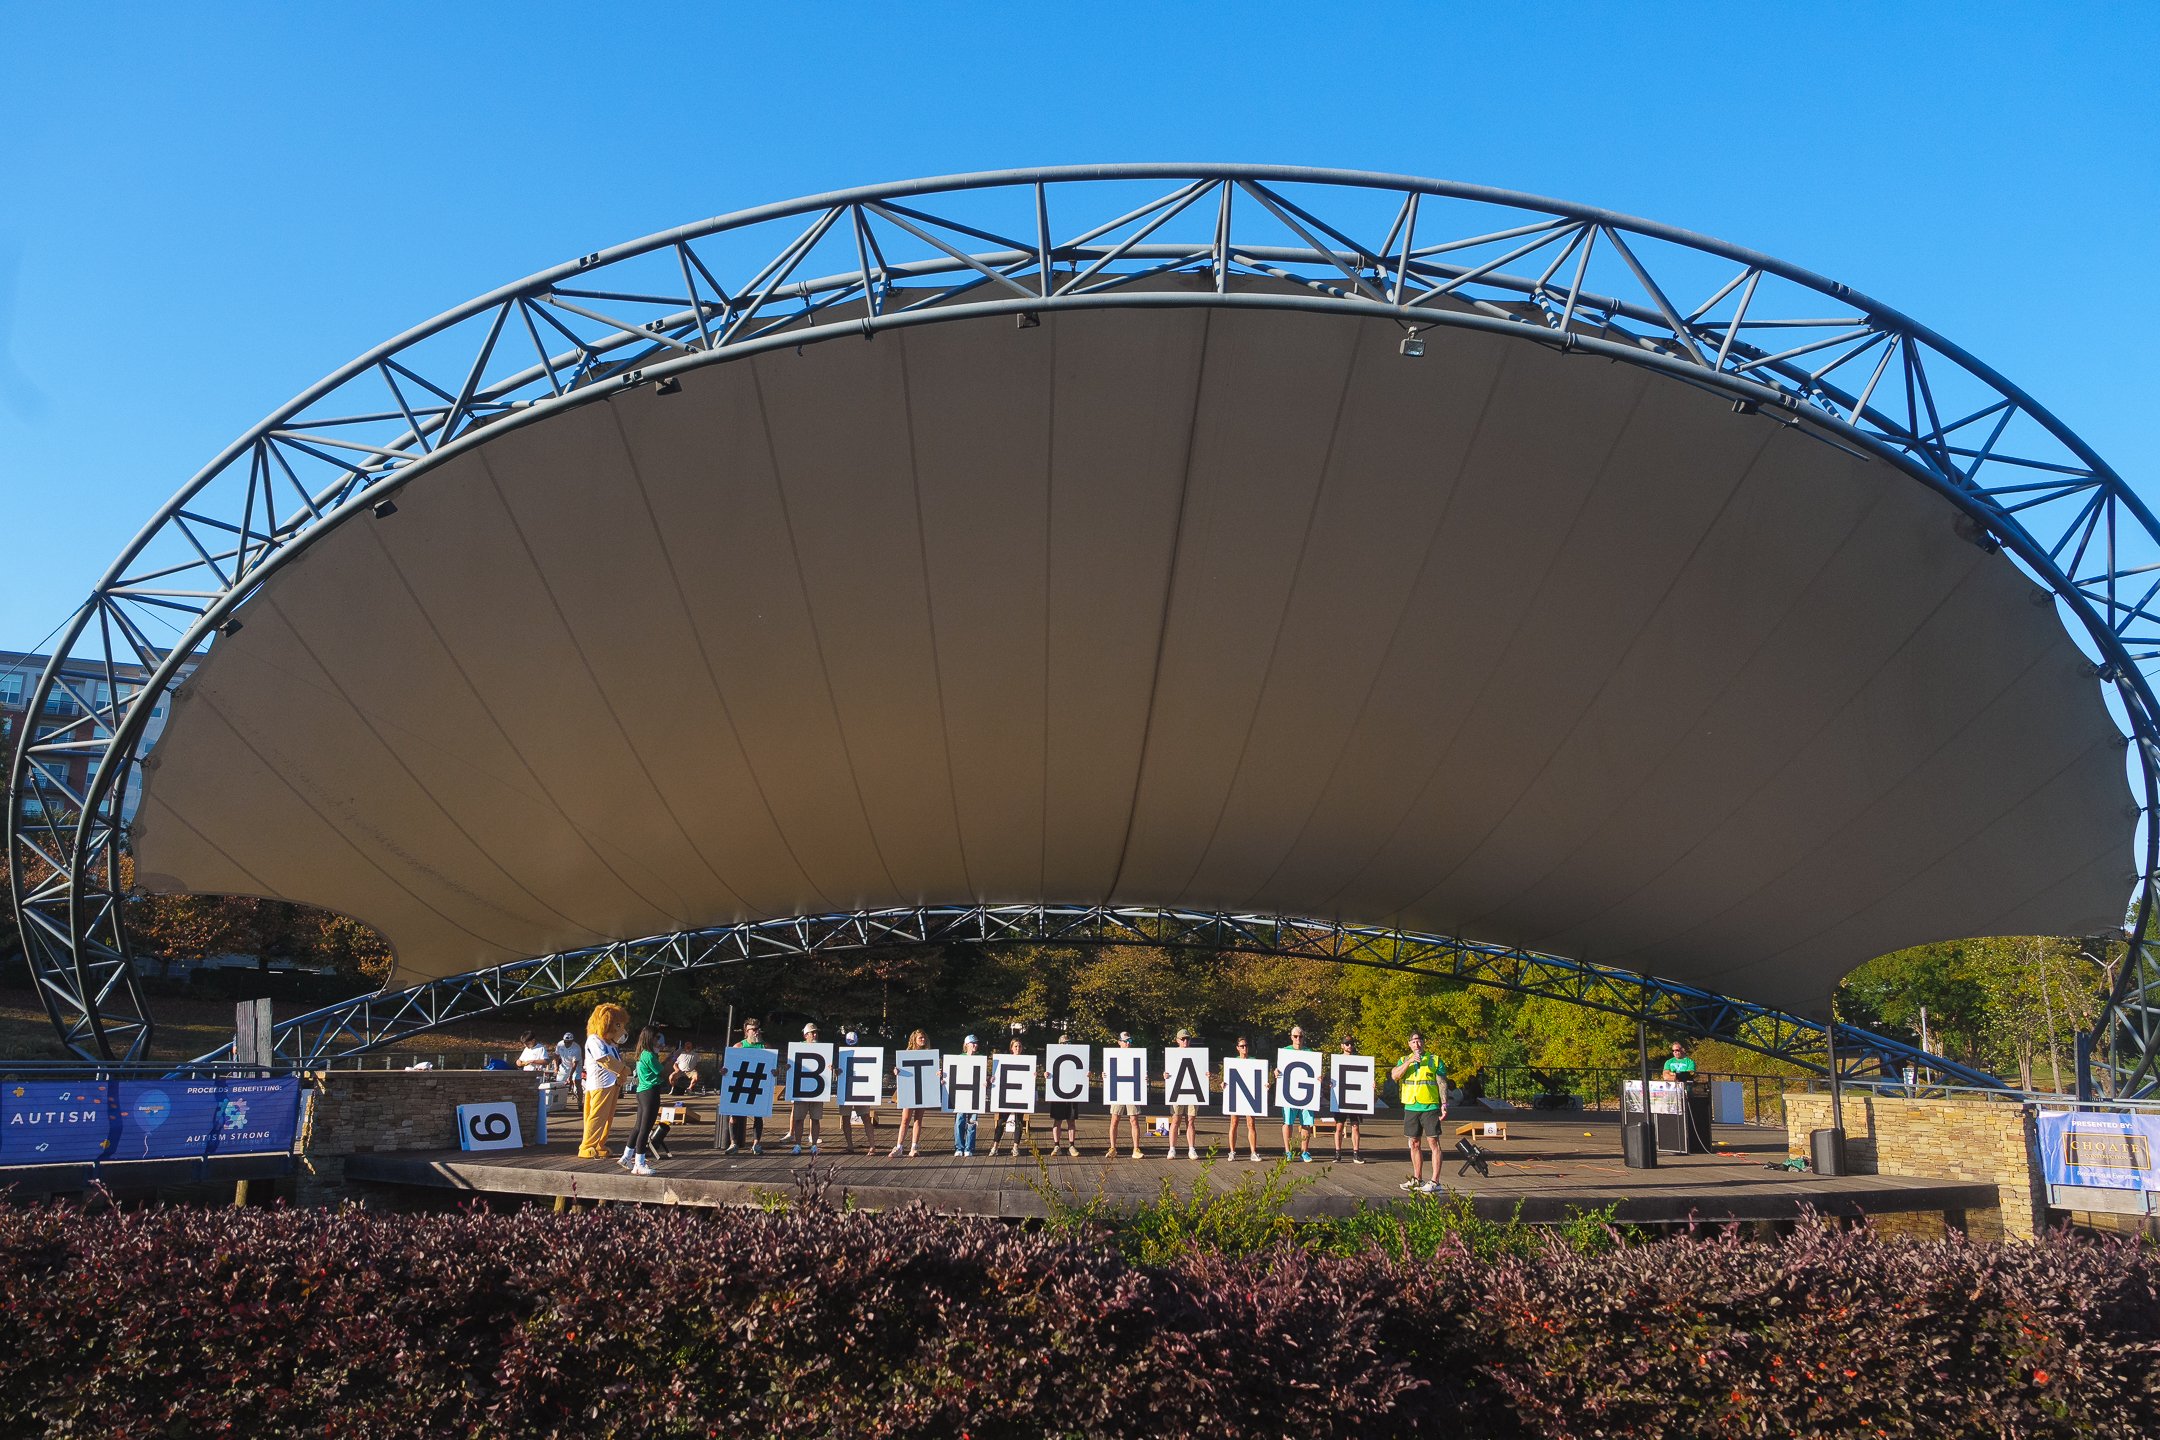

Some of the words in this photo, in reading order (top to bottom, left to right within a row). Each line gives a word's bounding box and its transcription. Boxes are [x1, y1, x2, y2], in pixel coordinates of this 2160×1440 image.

[232, 1085, 282, 1093] BENEFITTING:
[11, 1110, 96, 1125] AUTISM
[470, 1113, 512, 1142] 6
[1487, 1126, 1494, 1134] 6
[2071, 1120, 2118, 1128] PRESENTED
[186, 1132, 226, 1143] AUTISM
[230, 1131, 270, 1140] STRONG
[2070, 1140, 2140, 1153] CHOATE
